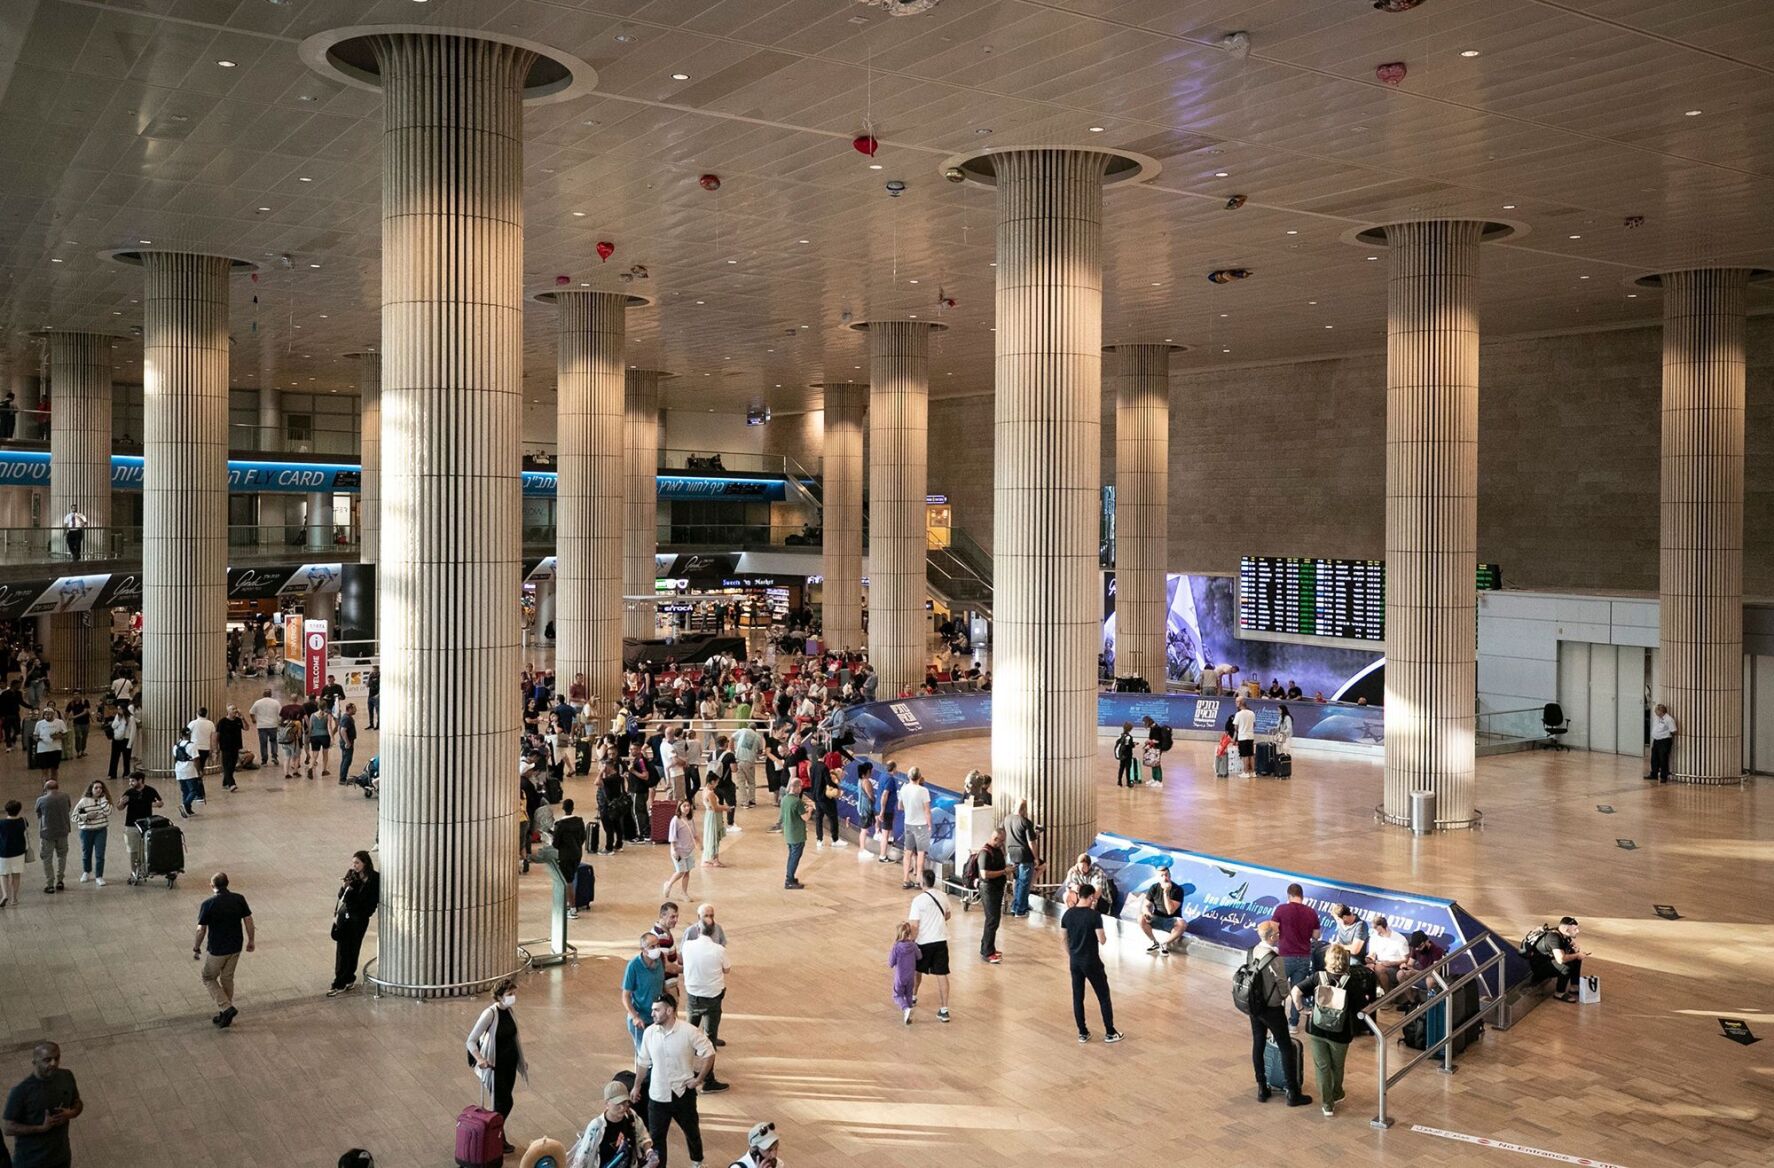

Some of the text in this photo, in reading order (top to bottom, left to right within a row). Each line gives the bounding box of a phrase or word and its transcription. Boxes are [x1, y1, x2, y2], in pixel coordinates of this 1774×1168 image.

[245, 469, 277, 485] FLY
[278, 470, 325, 486] CARD
[658, 479, 685, 495] לארץ
[710, 481, 725, 496] כיף
[1204, 893, 1218, 905] Ben
[1219, 897, 1247, 910] Gurion
[1498, 1142, 1569, 1161] No Entrance
